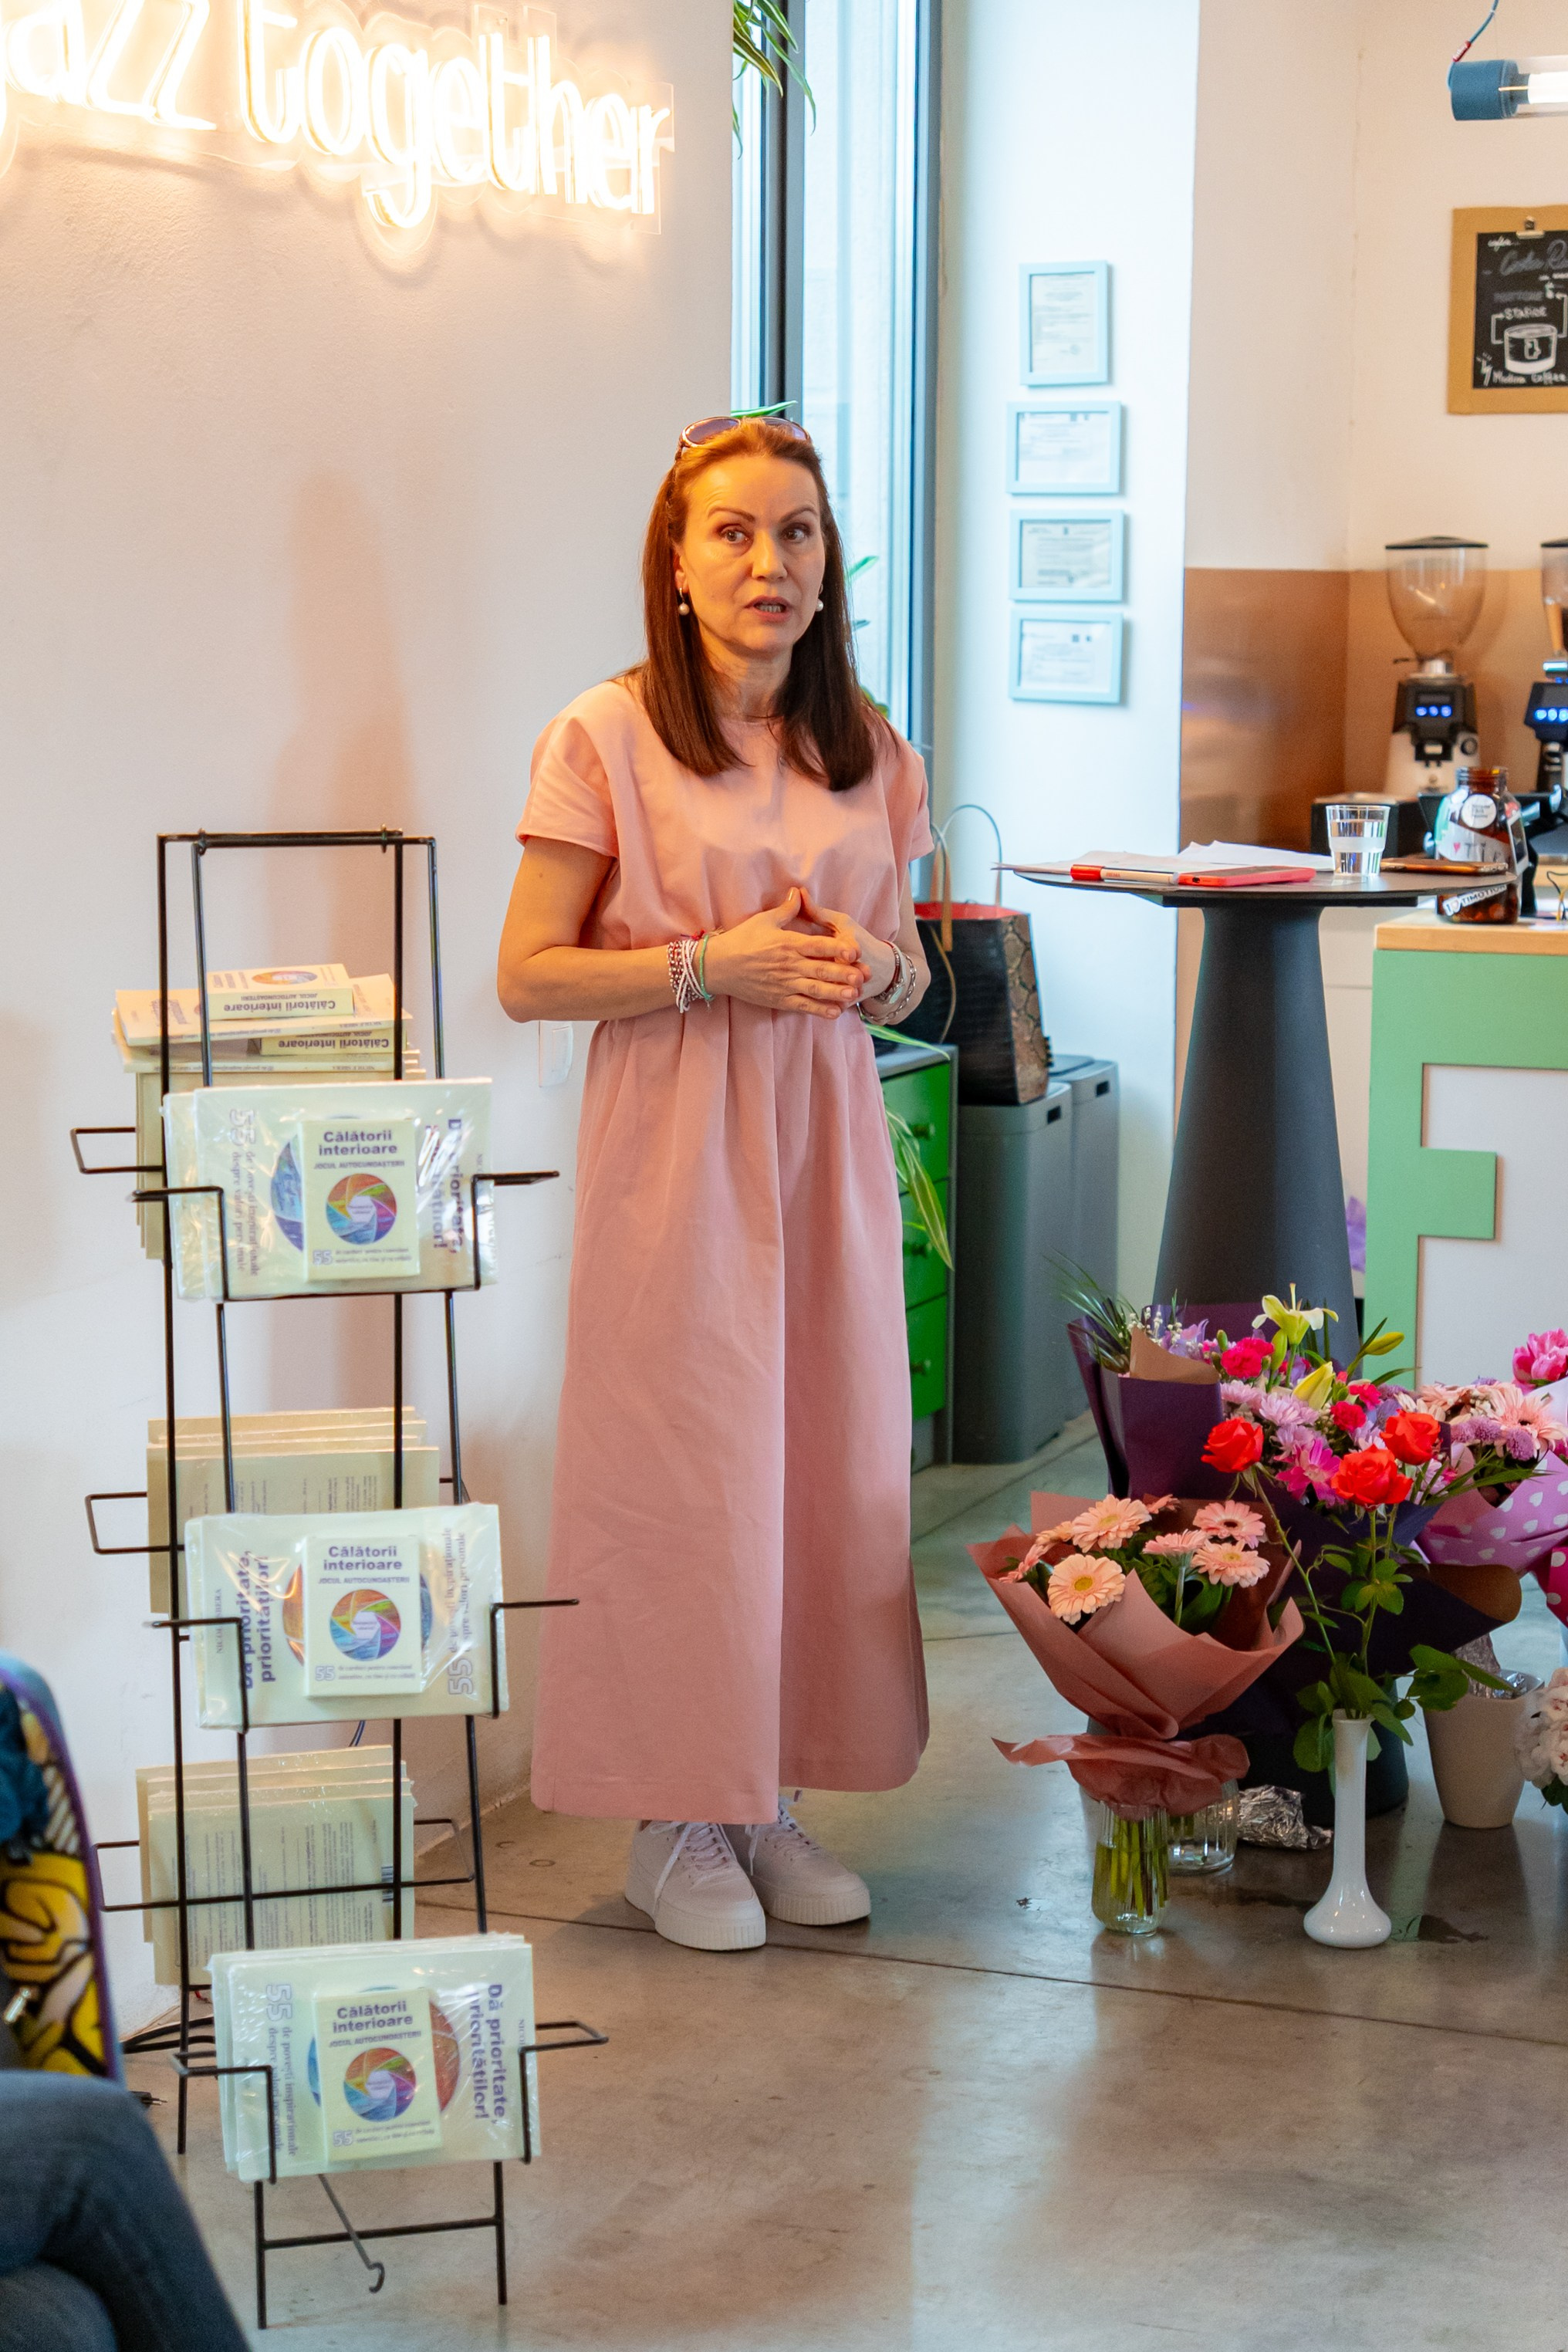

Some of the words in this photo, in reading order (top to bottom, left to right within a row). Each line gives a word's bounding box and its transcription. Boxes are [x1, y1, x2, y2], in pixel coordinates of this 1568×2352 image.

[0, 0, 218, 130] azz
[238, 0, 671, 228] together
[223, 1000, 284, 1013] interioare
[286, 999, 336, 1012] Călătorii
[278, 1036, 335, 1049] interioare
[338, 1036, 390, 1049] Călătorii
[323, 1129, 394, 1143] Călătorii
[319, 1143, 398, 1157] interioare
[313, 1249, 333, 1266] 55
[328, 1545, 397, 1559] Călătorii
[323, 1558, 403, 1572] interioare
[315, 1665, 336, 1681] 55
[447, 1658, 474, 1695] 55
[265, 1983, 292, 2021] 55
[488, 1983, 504, 2012] Dă
[336, 2000, 407, 2019] Călătorii
[332, 2015, 414, 2034] interioare
[333, 2130, 354, 2148] 55
